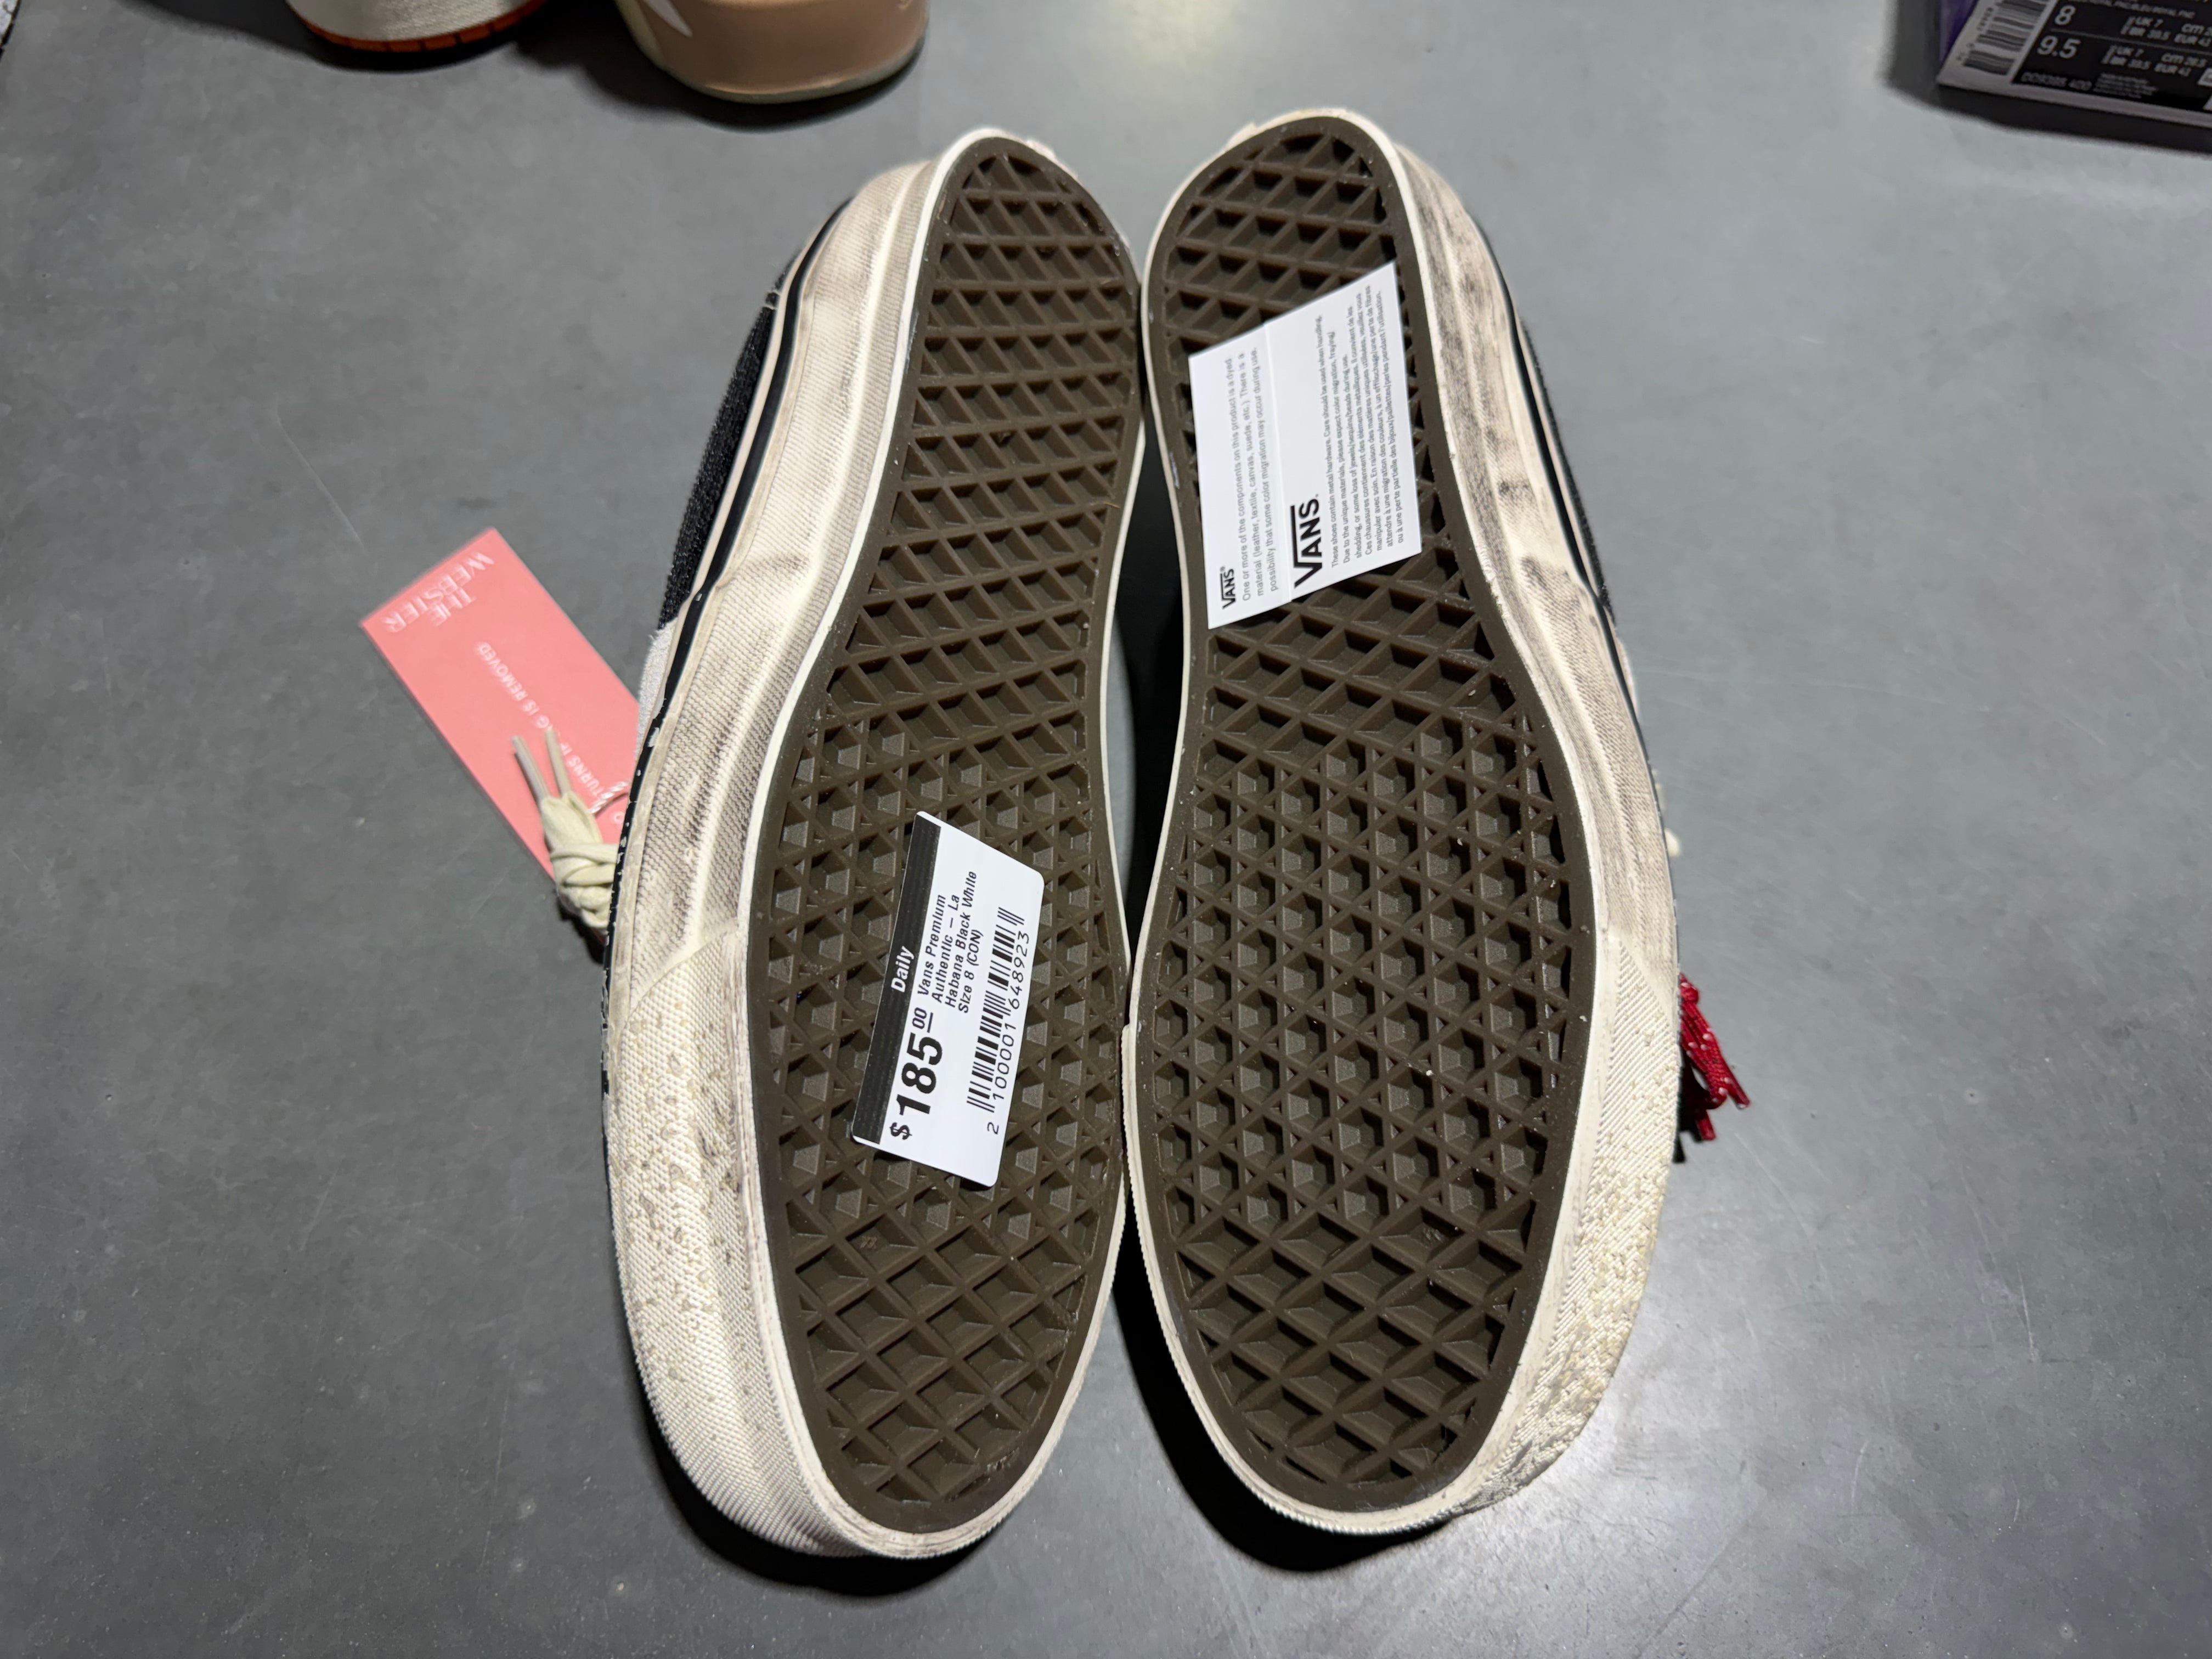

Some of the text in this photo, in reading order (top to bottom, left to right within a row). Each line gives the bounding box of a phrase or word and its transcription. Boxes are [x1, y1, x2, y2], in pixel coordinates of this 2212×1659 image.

[2054, 5, 2076, 25] 8
[2037, 35, 2082, 59] 9.5
[1347, 317, 1354, 327] de
[1367, 307, 1373, 318] de
[1368, 317, 1376, 337] perte
[1379, 331, 1389, 363] pendant
[1224, 357, 1234, 380] dyed
[1239, 362, 1245, 370] is
[1252, 365, 1261, 394] during
[1331, 359, 1340, 395] migration,
[1228, 387, 1235, 397] is
[1239, 371, 1248, 399] There
[1321, 385, 1327, 396] be
[1342, 368, 1351, 393] during
[1255, 394, 1263, 419] occur
[1321, 394, 1329, 419] should
[1376, 393, 1381, 403] un
[1228, 397, 1239, 431] product
[1377, 409, 1385, 444] couleurs,
[1244, 421, 1253, 452] suede,
[1234, 449, 1240, 461] on
[1259, 438, 1269, 479] migration
[1325, 437, 1333, 473] hardware.
[1247, 453, 1256, 488] canvas,
[1338, 463, 1347, 499] materials,
[1349, 469, 1357, 478] of
[1359, 453, 1369, 498] contiennent
[1370, 467, 1378, 478] En
[1381, 458, 1390, 493] migration
[1390, 459, 1400, 490] partielle
[1234, 461, 1245, 517] components
[1262, 481, 1270, 503] color
[1394, 490, 1402, 512] perte
[1249, 488, 1258, 520] textile,
[1355, 515, 1360, 523] or
[1363, 498, 1372, 540] chaussures
[1374, 515, 1383, 551] manipuler
[1384, 515, 1393, 548] attendre
[1238, 534, 1246, 544] of
[1251, 519, 1262, 557] (leather,
[1265, 528, 1273, 547] that
[1343, 539, 1350, 548] to
[1353, 523, 1366, 558] shedding,
[1364, 540, 1373, 555] Ces
[1398, 533, 1403, 544] ou
[1266, 547, 1278, 592] possibility
[1342, 548, 1351, 563] Due
[1243, 569, 1249, 579] or
[1254, 559, 1264, 596] material
[1242, 580, 1251, 601] One
[430, 588, 477, 627] THE
[476, 641, 528, 701] REMOVED
[523, 699, 540, 716] IS
[917, 894, 946, 996] Vans Premium
[932, 935, 953, 1003] Authentic
[948, 895, 960, 911] La
[945, 871, 977, 1007] Habana Black White
[891, 945, 915, 992] Daily
[958, 929, 984, 1013] Size 8 (CON)
[988, 1121, 999, 1135] 2
